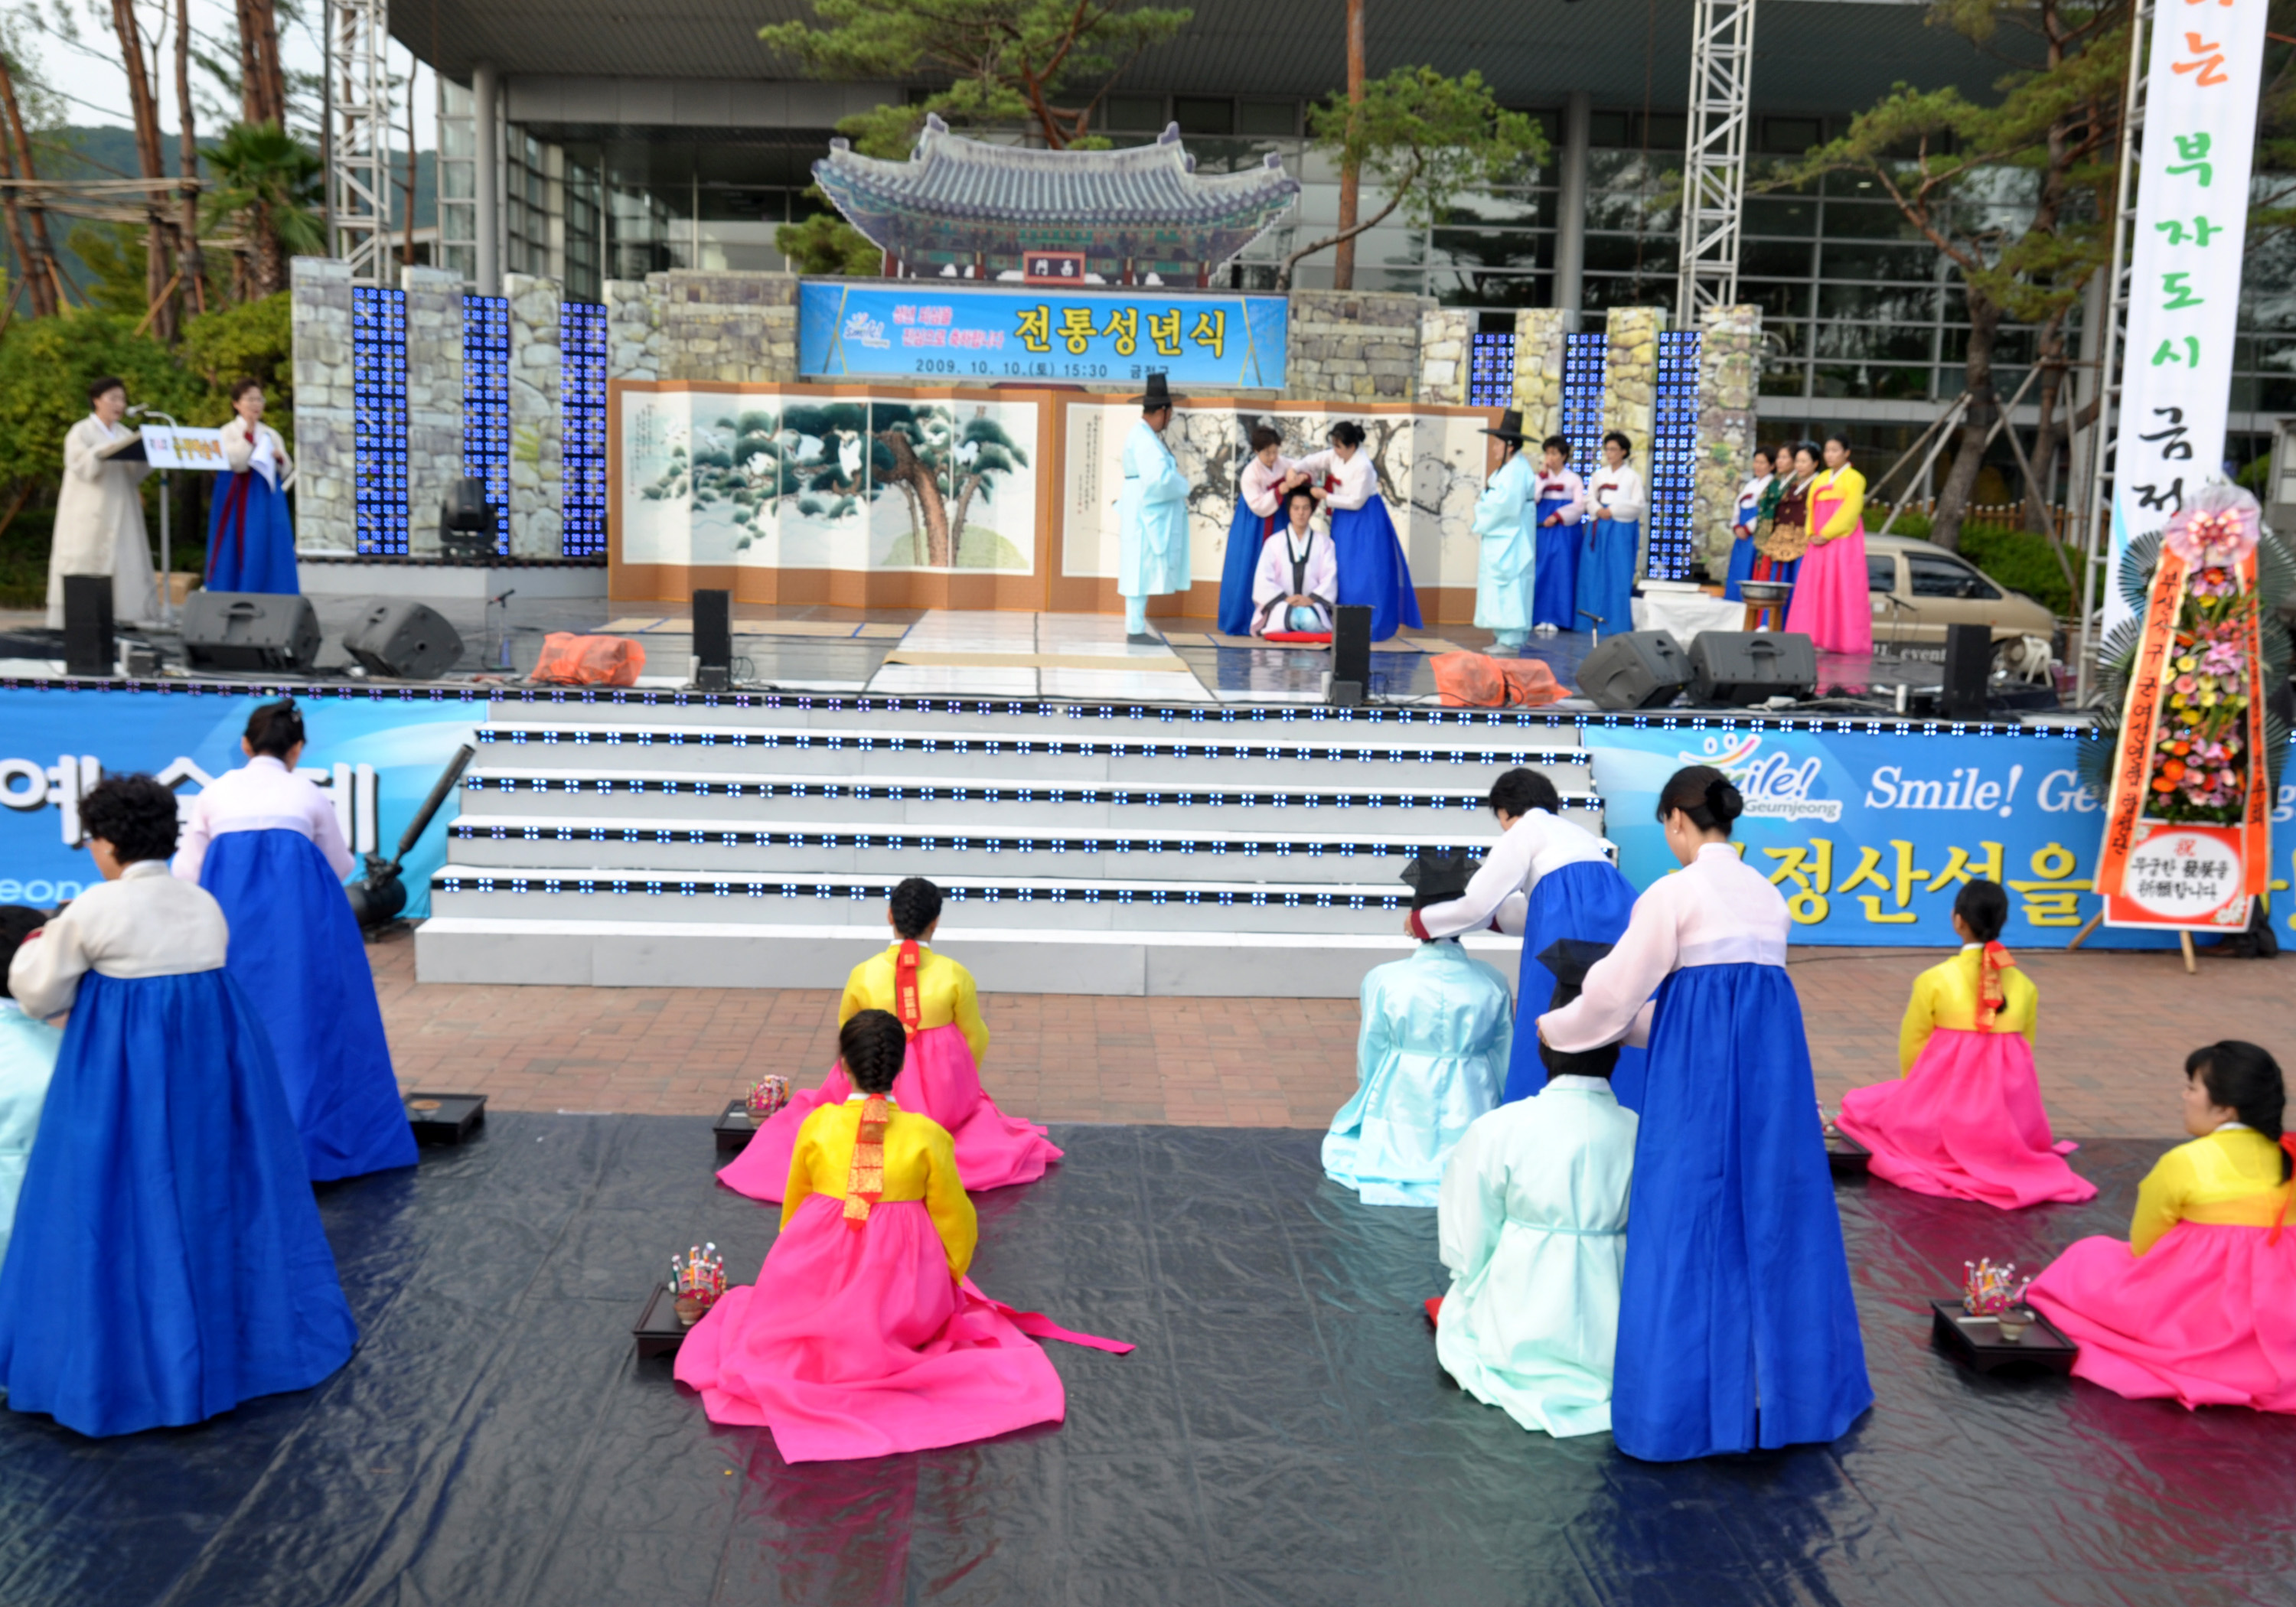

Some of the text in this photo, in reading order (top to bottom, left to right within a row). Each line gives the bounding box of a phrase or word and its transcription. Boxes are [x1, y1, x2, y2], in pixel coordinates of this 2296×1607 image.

[2170, 0, 2233, 87] 는
[1014, 304, 1226, 359] 전통성년식
[916, 359, 961, 373] 2009.
[970, 360, 994, 375] 10.
[1064, 363, 1107, 377] 15:30
[1744, 799, 1838, 818] Geumjeong
[1864, 764, 2024, 818] Smile!
[0, 878, 106, 902] eon
[1668, 839, 2094, 926] 정산성을
